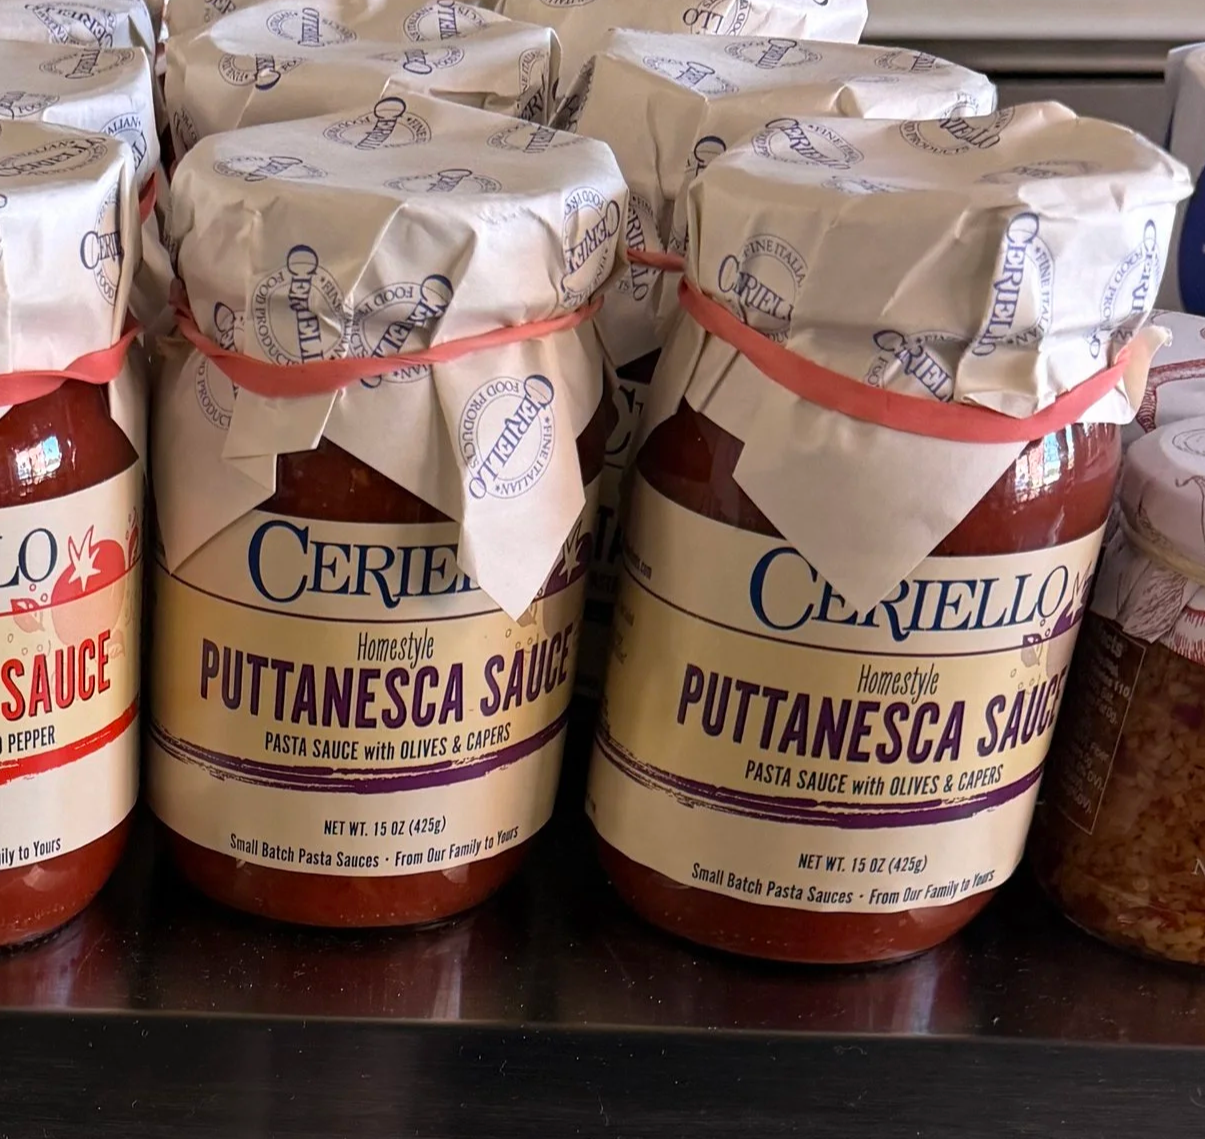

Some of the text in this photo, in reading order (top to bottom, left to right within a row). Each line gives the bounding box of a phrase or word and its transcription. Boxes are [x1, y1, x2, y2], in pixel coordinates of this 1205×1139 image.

[775, 242, 807, 288] ITALIA
[254, 272, 284, 308] FOOD
[375, 286, 414, 307] FOOD
[462, 381, 519, 468] FOOD PRODUCTS
[469, 374, 554, 499] CERIELLO
[500, 425, 552, 495] FINE ITALIAN
[248, 519, 480, 609] CERIE
[357, 627, 435, 670] Homestyle
[0, 628, 112, 721] SAUCE
[200, 624, 572, 730] PUTTANESCA SAUCE
[856, 663, 939, 706] Homestyle
[676, 662, 967, 765] PUTTANESCA
[7, 725, 56, 755] PEPPER
[264, 722, 512, 762] PASTA SAUCE with OLIVES & CAPERS
[745, 760, 1004, 796] PASTA SAUCE with OLIVES & CAPERS
[230, 825, 519, 869] Small Batch Pasta Sauces From Our Family to Yours
[323, 816, 447, 837] NET WT. 15 OZ (425g)
[18, 844, 31, 861] to
[33, 836, 61, 856] Yours
[798, 853, 928, 875] NET WT. 15 OZ (425g)
[691, 862, 995, 905] Small Batch Pasta Sauces From Our Family to Yours
